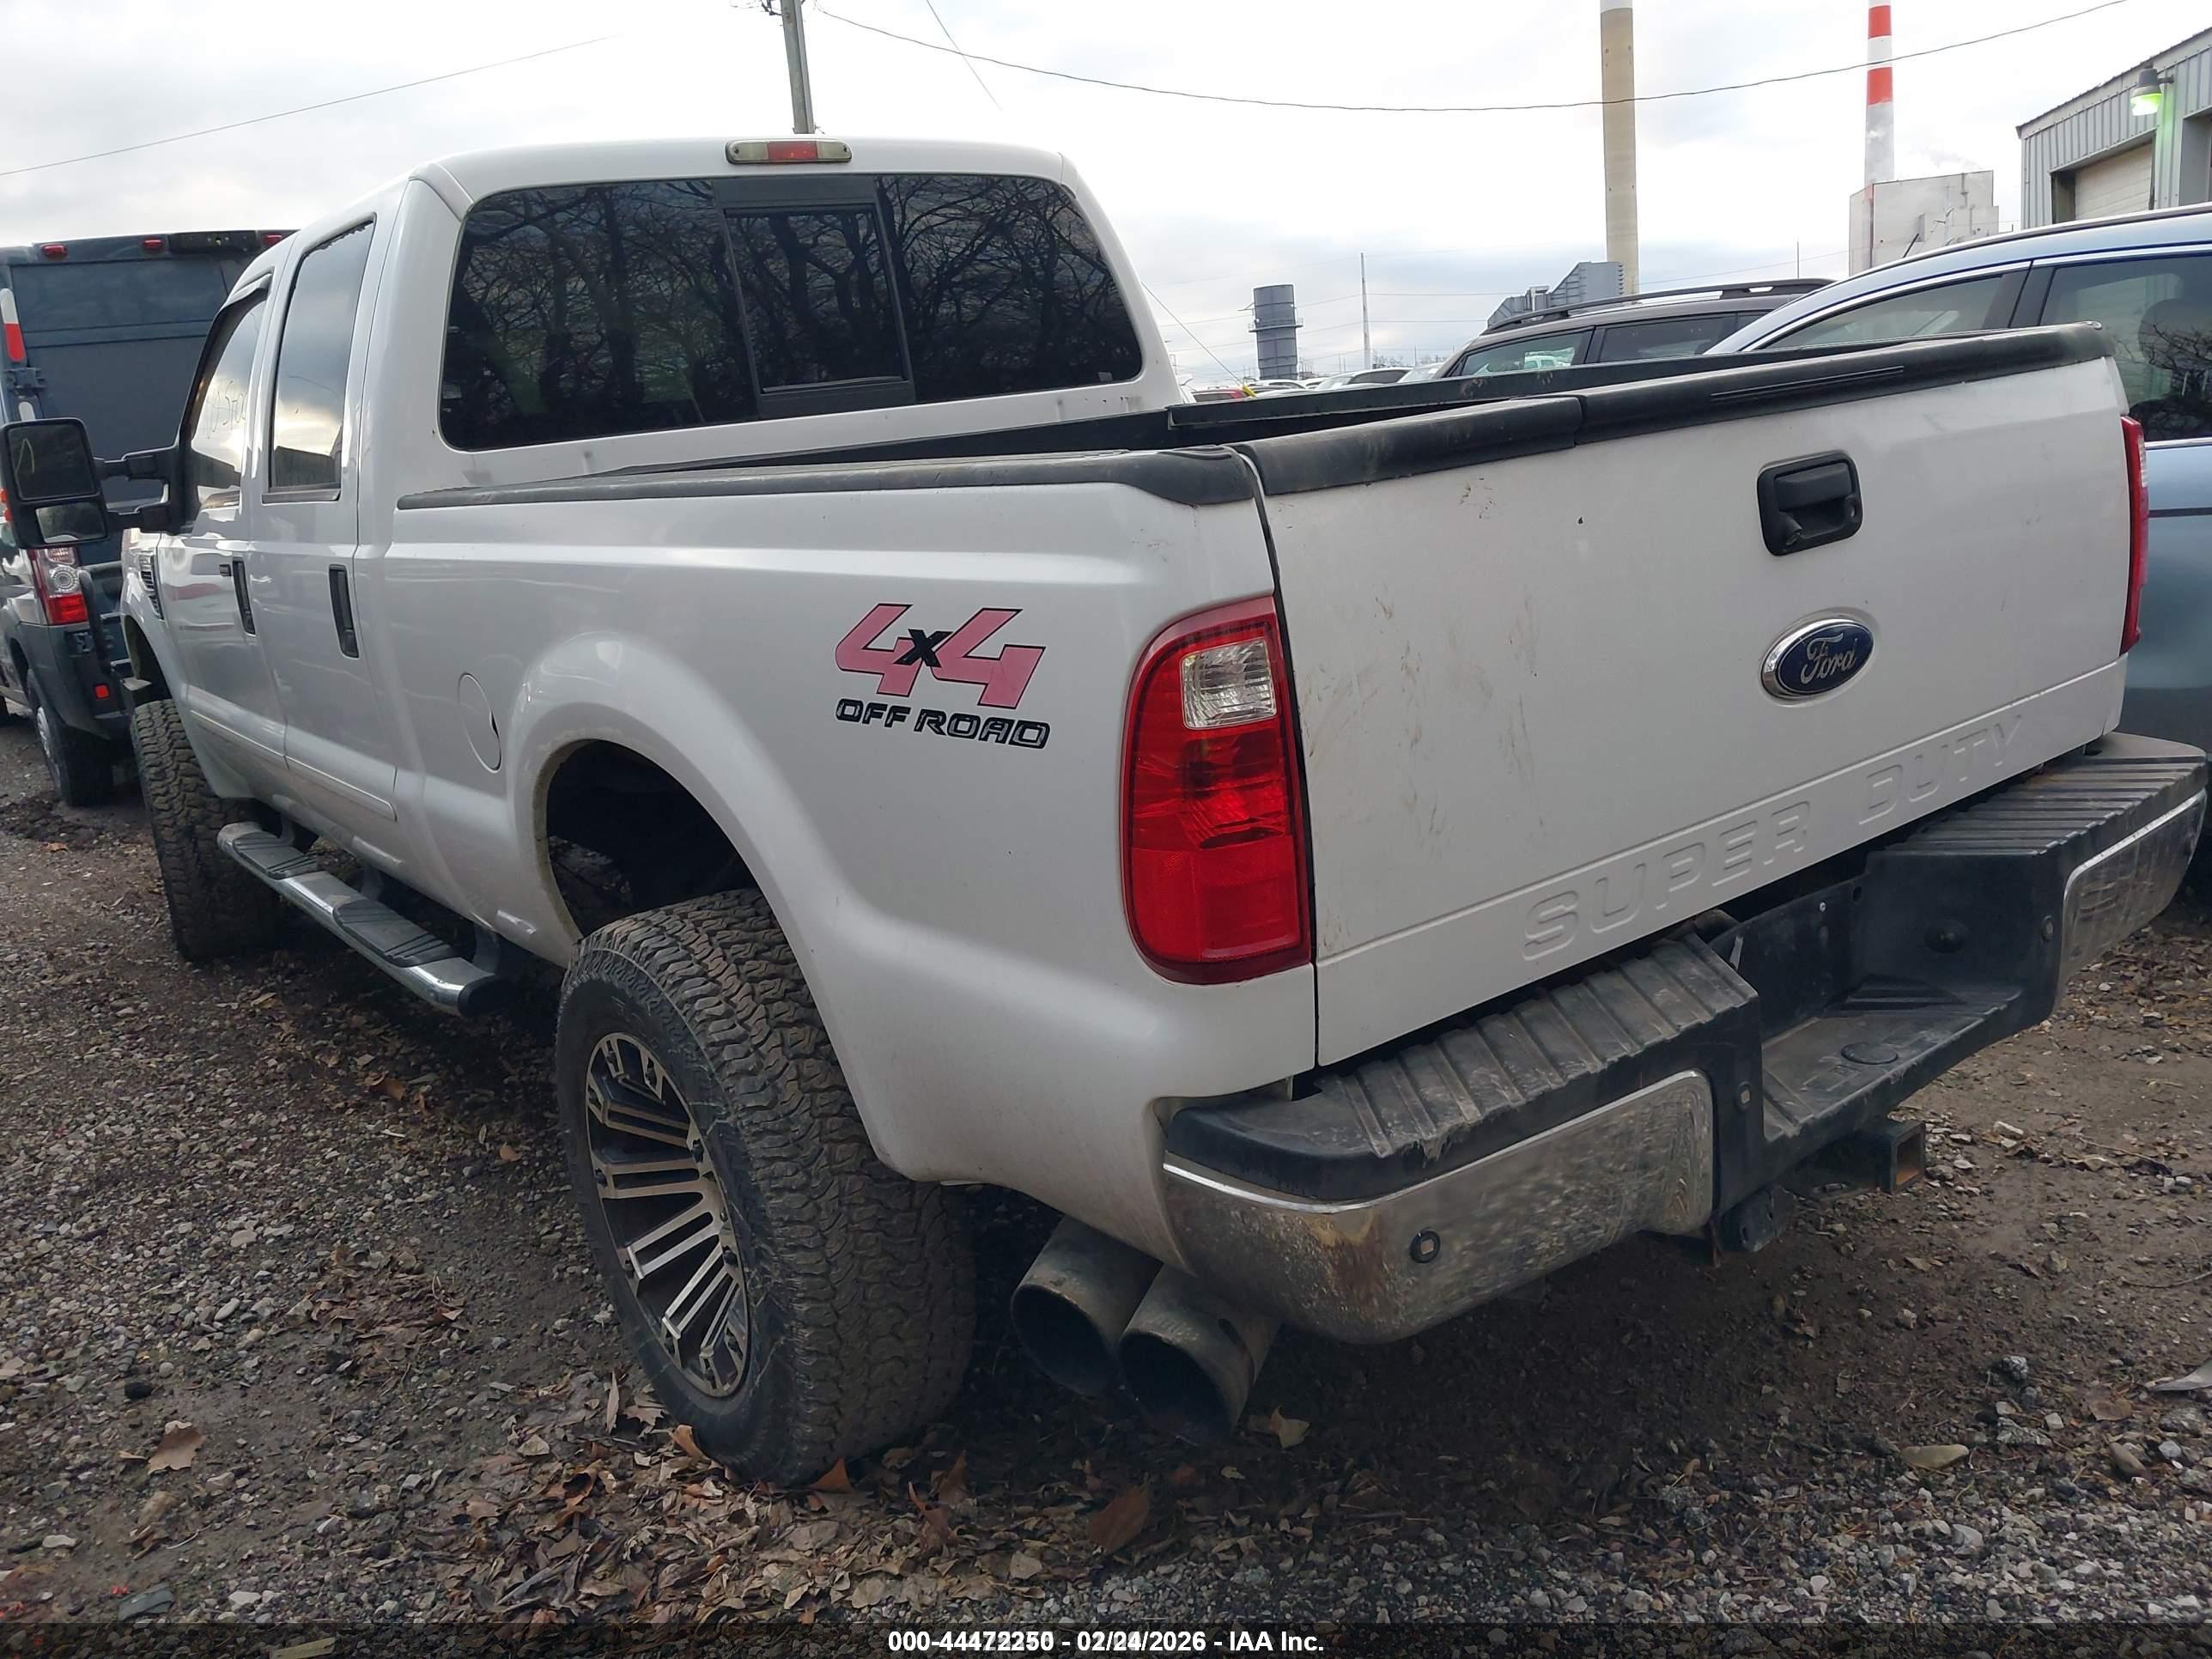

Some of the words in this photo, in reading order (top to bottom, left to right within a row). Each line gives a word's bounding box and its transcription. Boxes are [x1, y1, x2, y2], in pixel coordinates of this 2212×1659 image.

[1800, 633, 1858, 684] Ford
[836, 698, 911, 728] OFF
[914, 708, 1050, 750] ROAD
[1522, 801, 1810, 961] SUPER
[1857, 714, 2022, 825] DUTY
